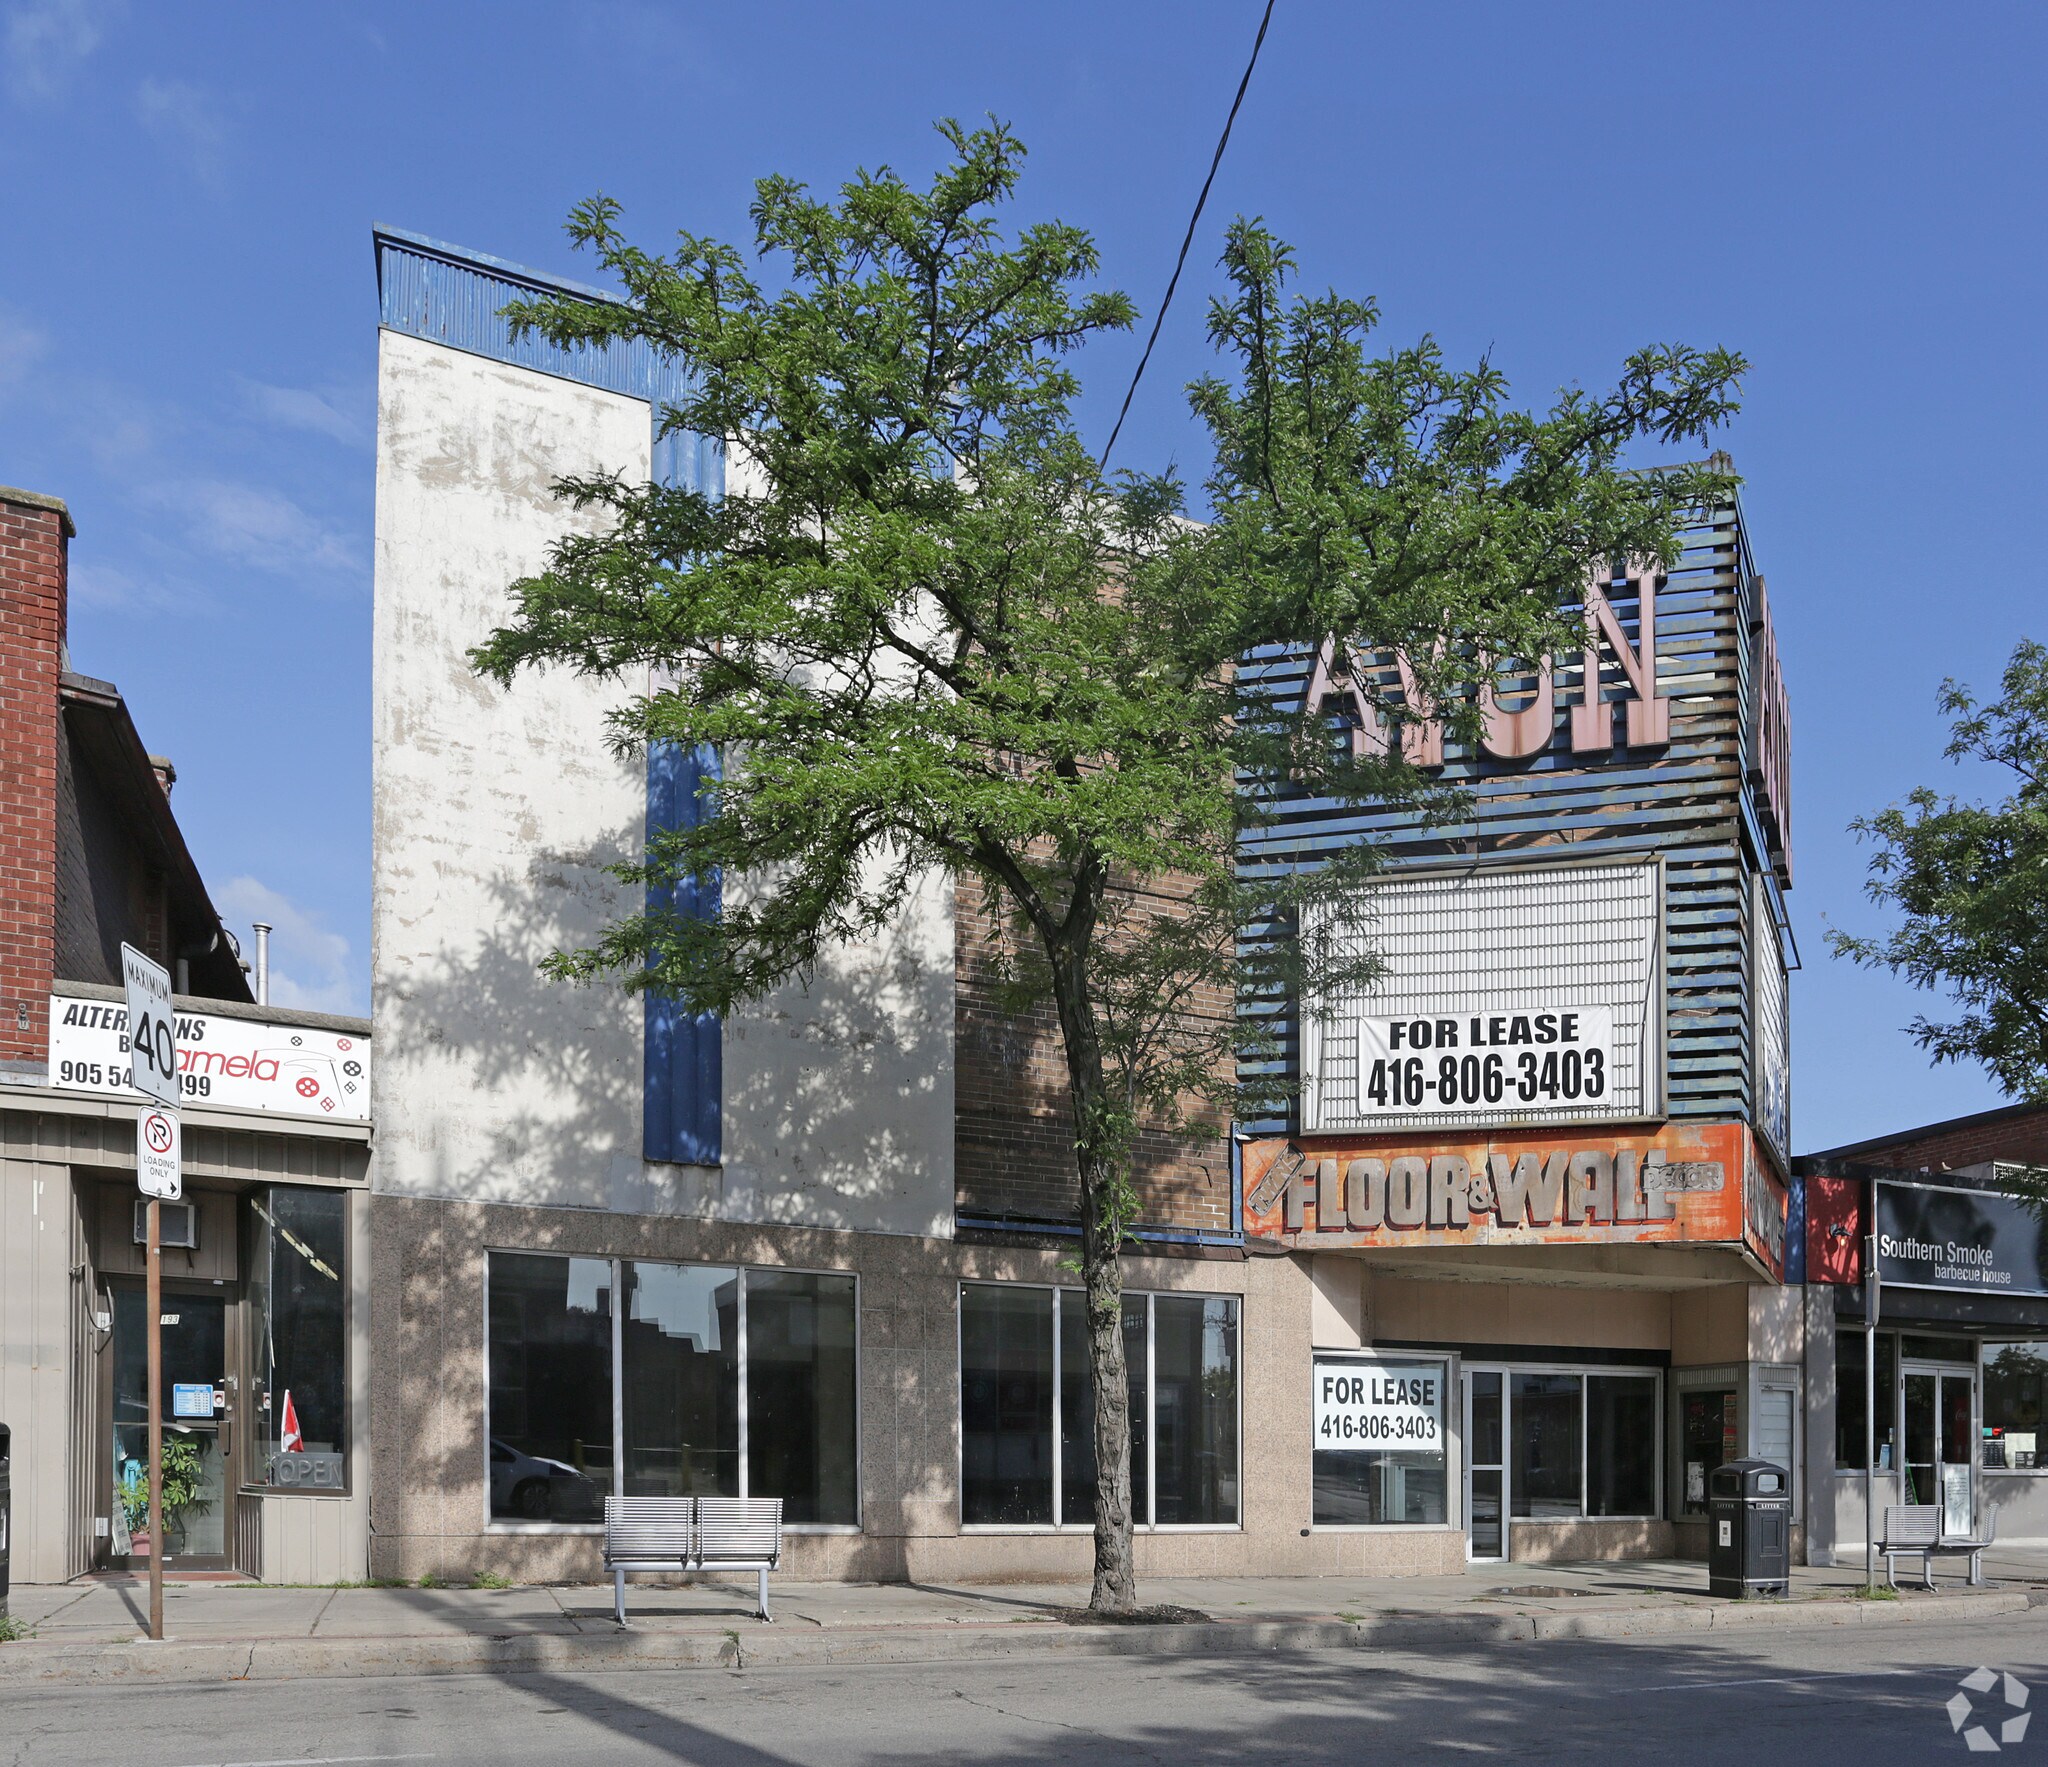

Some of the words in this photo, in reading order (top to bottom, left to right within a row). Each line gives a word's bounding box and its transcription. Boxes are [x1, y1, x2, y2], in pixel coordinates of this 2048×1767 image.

[127, 959, 169, 1004] MAXIMUM
[62, 1003, 206, 1041] ALTERNS
[1389, 1019, 1459, 1050] FOR
[1470, 1013, 1580, 1046] LEASE
[134, 1011, 174, 1080] 40
[60, 1060, 102, 1085] 905
[176, 1049, 280, 1082] amela
[1367, 1047, 1605, 1107] 416-806-3403
[143, 1155, 175, 1169] LOADING
[149, 1167, 169, 1178] ONLY
[1643, 1164, 1720, 1189] DECOR
[1283, 1154, 1470, 1234] FLOOR
[1487, 1149, 1677, 1229] WALL
[1880, 1234, 1943, 1262] Southern
[1947, 1241, 1993, 1266] Smoke
[1934, 1263, 1980, 1281] barbecue
[1982, 1267, 2011, 1284] house
[161, 1314, 179, 1324] 193
[1322, 1376, 1365, 1405] FOR
[1371, 1378, 1435, 1406] LEASE
[1320, 1413, 1436, 1439] 416-806-3403
[280, 1459, 344, 1484] OPEN
